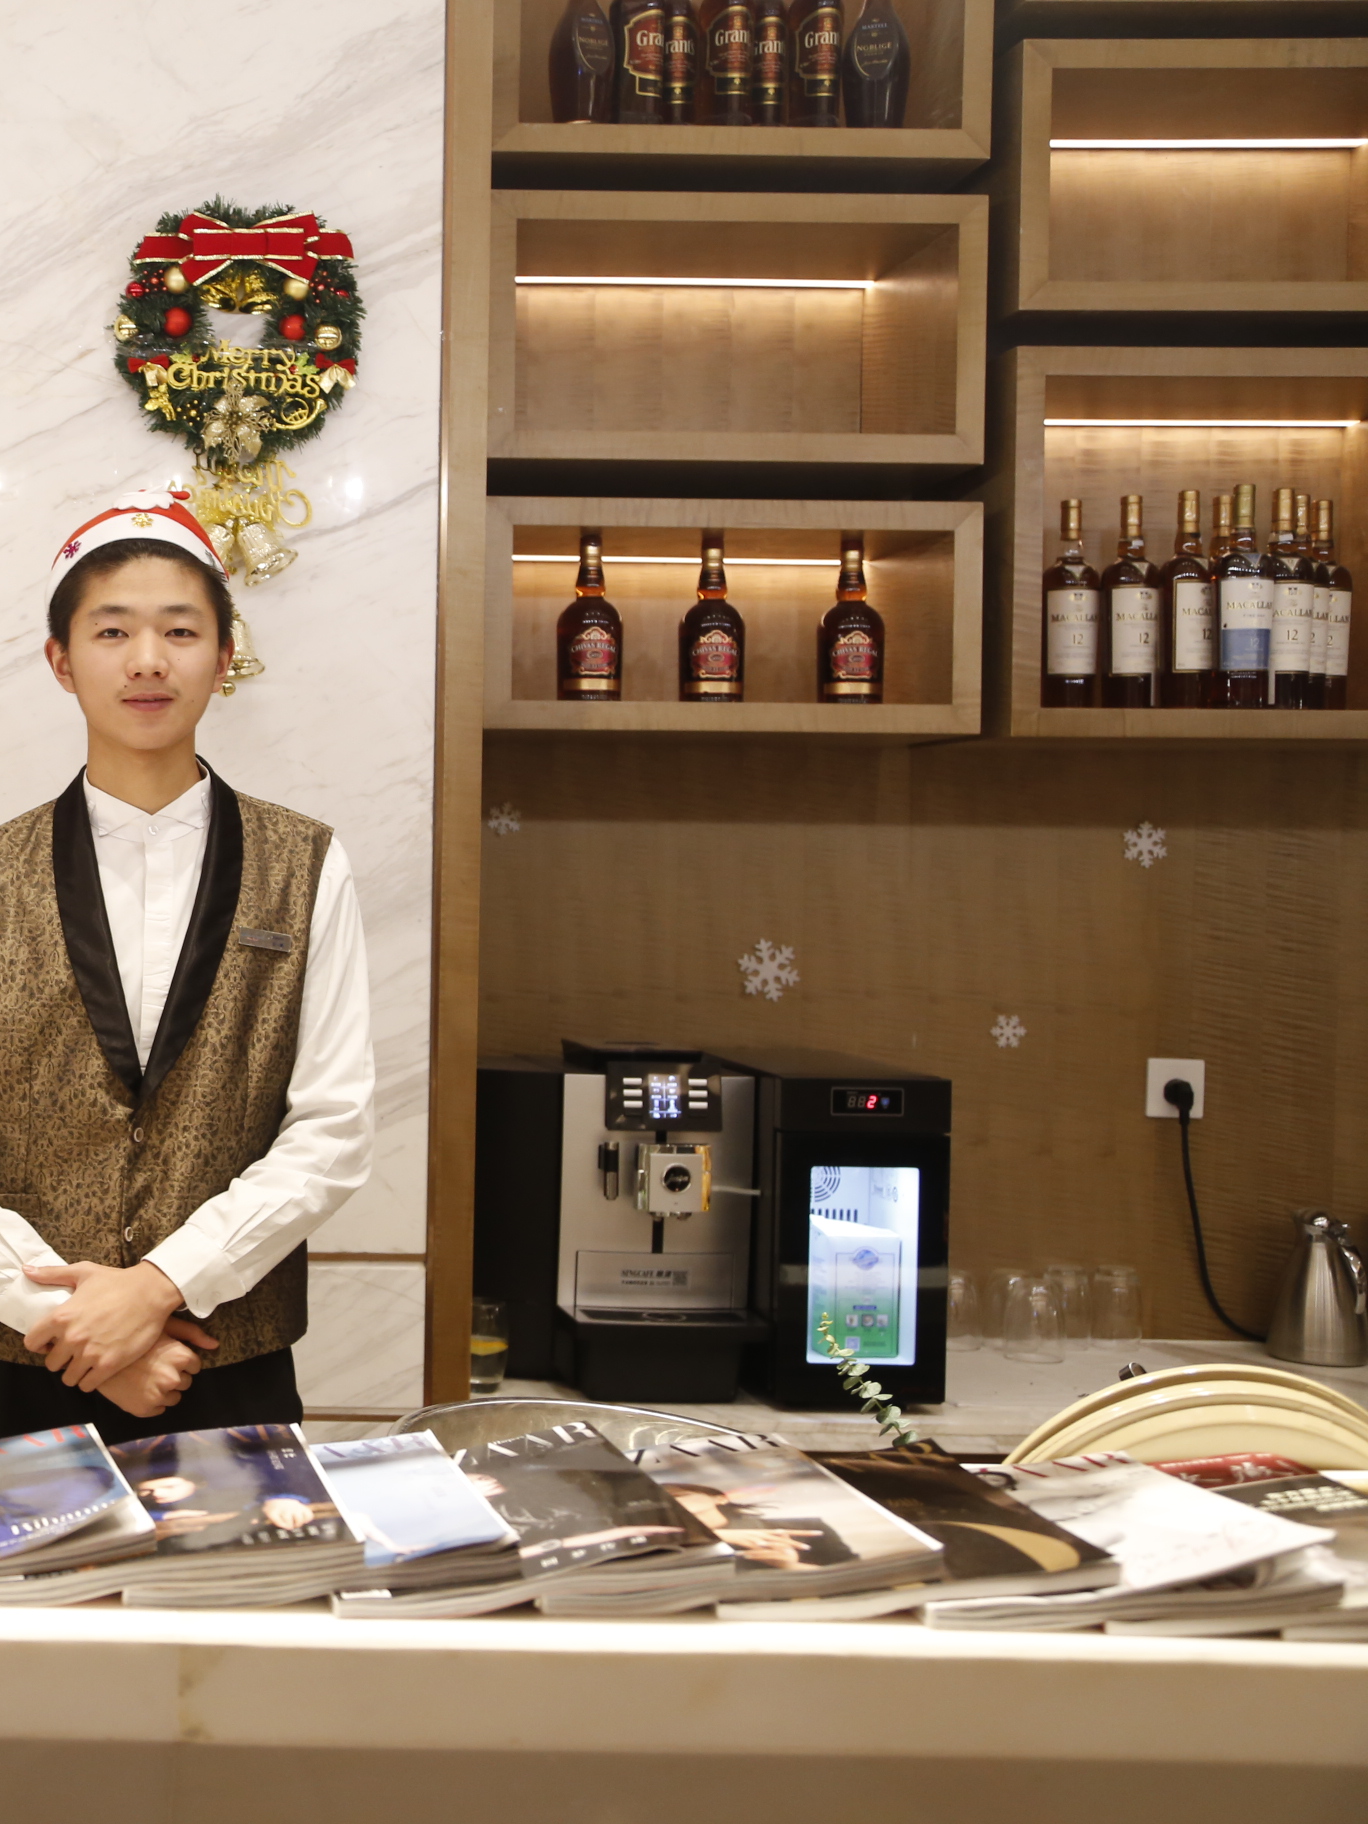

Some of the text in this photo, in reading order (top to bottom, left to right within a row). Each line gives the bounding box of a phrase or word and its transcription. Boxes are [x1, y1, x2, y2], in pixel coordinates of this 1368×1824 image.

[636, 29, 665, 48] Gra
[714, 29, 751, 47] Gran
[804, 31, 839, 48] Gran
[856, 41, 892, 52] NOBLIGE
[202, 339, 296, 371] Merry
[167, 362, 322, 399] Christmas
[1072, 633, 1084, 645] 12
[1138, 632, 1150, 644] 12
[1286, 629, 1299, 641] 12
[571, 642, 616, 653] CHIVAS REGAL
[1249, 637, 1260, 647] 12
[692, 645, 738, 656] CHIVAS REGAL
[832, 646, 878, 657] CHIVAS REGAL
